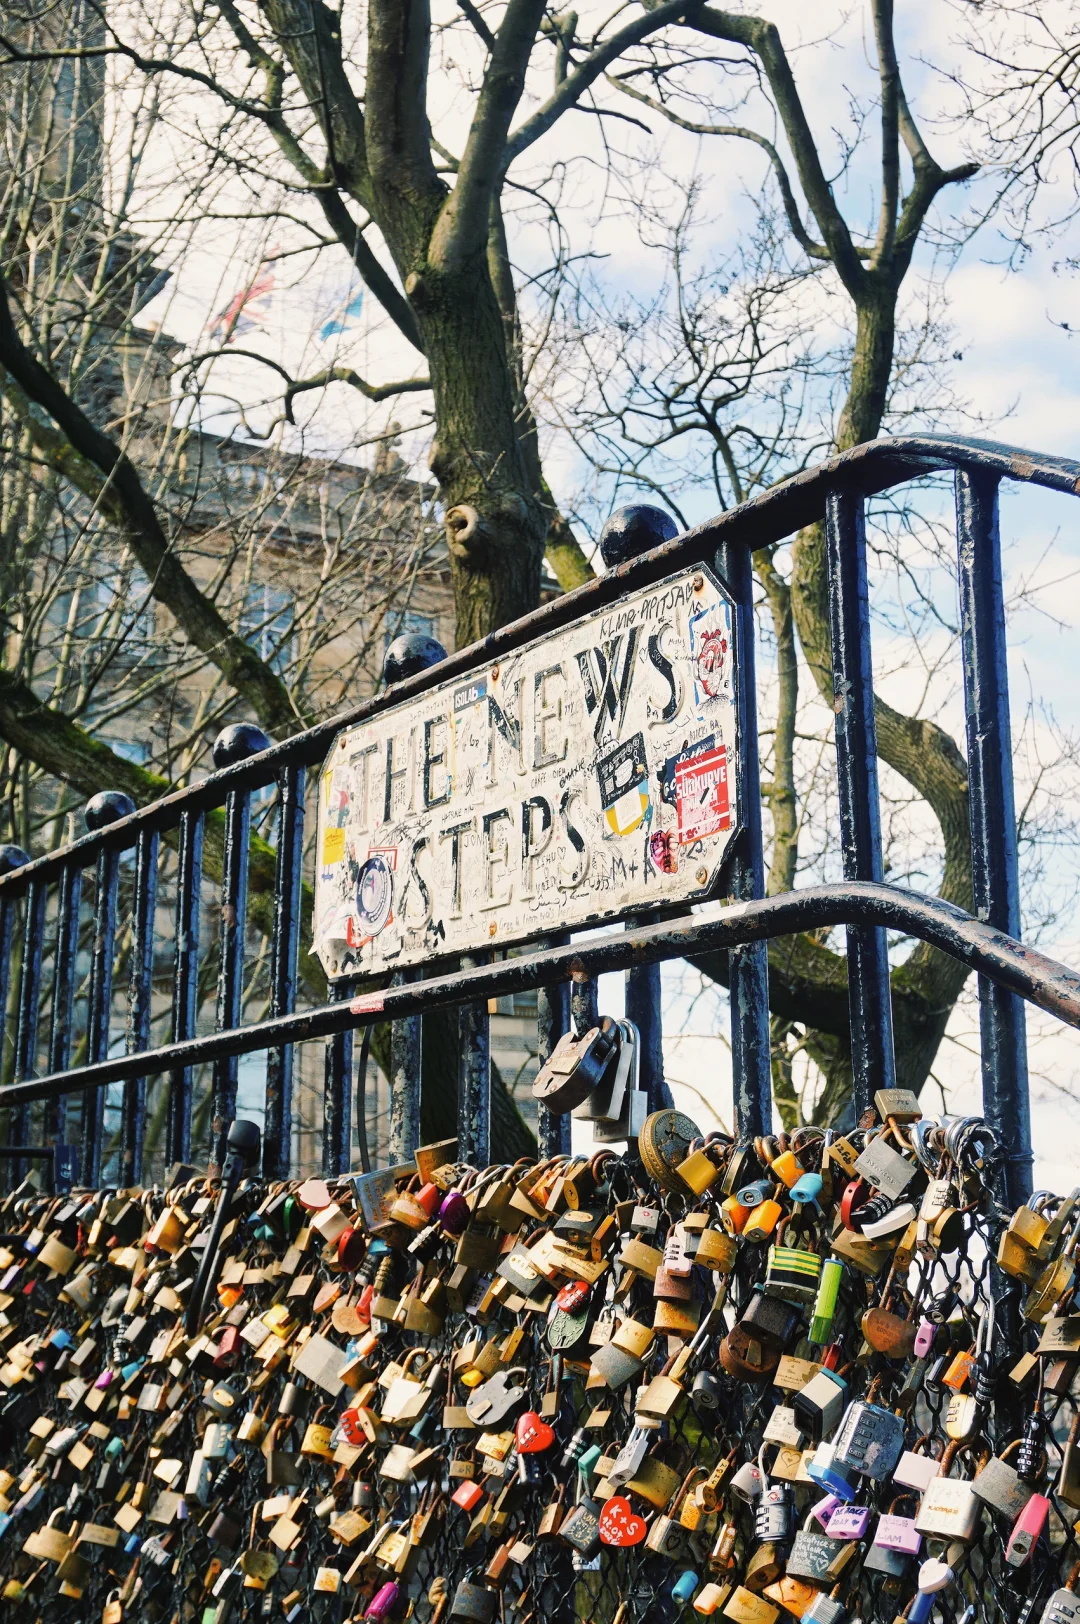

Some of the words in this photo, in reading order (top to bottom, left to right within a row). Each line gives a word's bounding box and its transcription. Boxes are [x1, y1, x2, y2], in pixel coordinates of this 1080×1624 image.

[349, 714, 452, 837] THE
[485, 622, 685, 790] NEWS
[404, 787, 591, 932] STEPS
[626, 1522, 639, 1536] S
